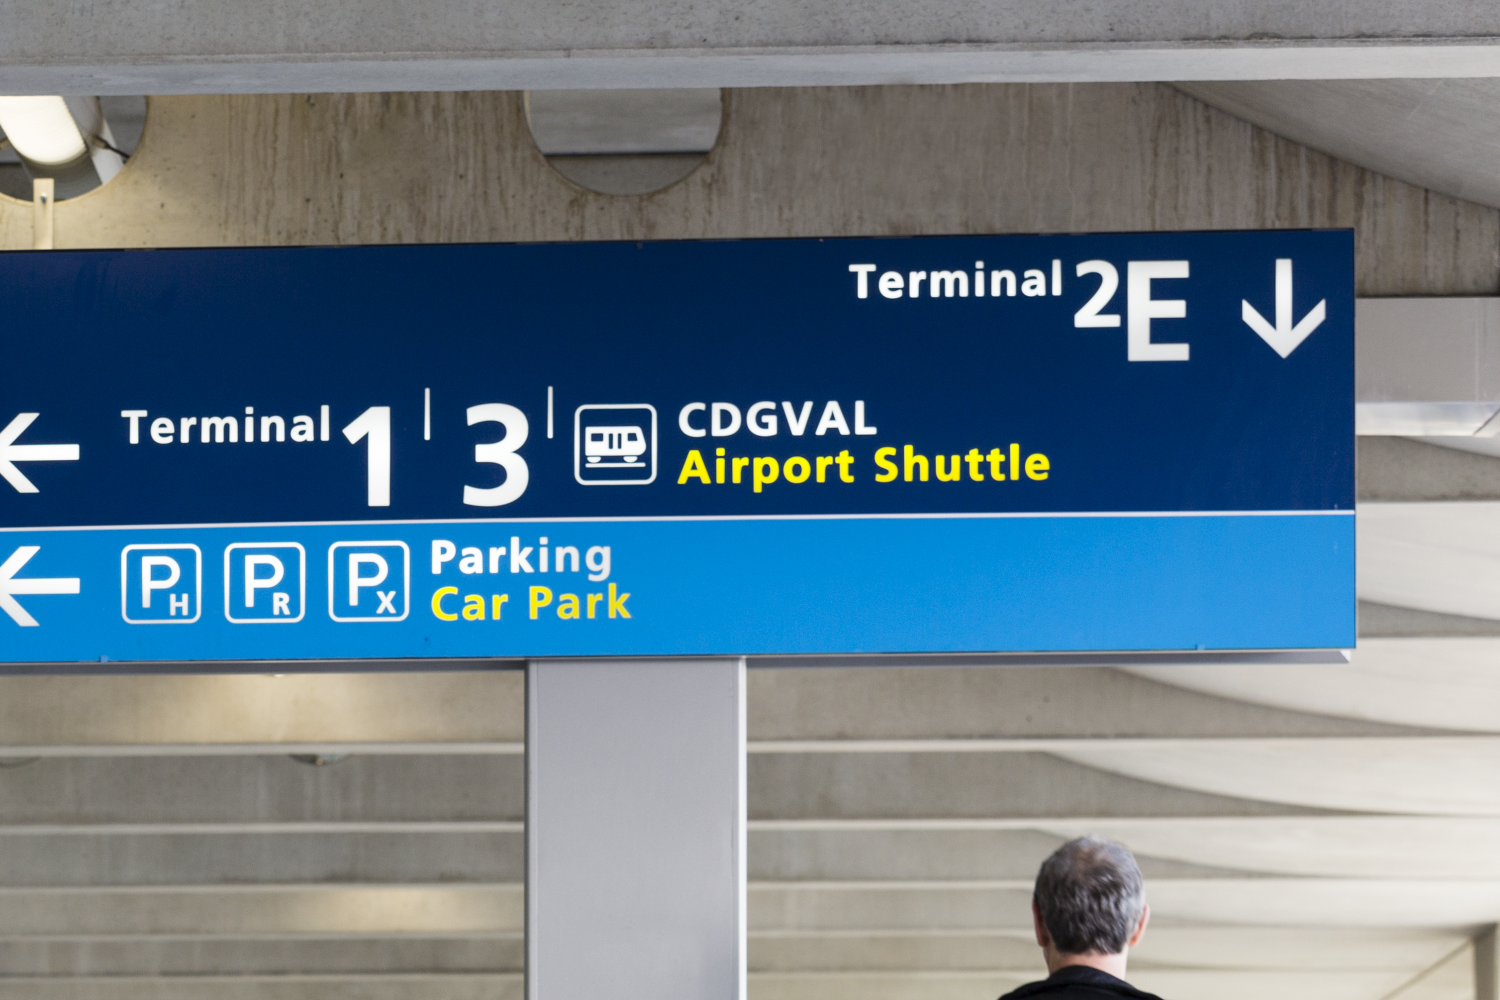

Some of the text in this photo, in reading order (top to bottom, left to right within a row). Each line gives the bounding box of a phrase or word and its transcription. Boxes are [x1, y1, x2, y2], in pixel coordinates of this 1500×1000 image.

[849, 260, 1189, 361] Terminal 2E
[679, 401, 876, 437] CDGVAL
[121, 404, 528, 506] Terminal 1 3
[678, 444, 1049, 492] Airport Shuttle
[432, 537, 610, 581] Parking
[432, 583, 631, 621] Car Park
